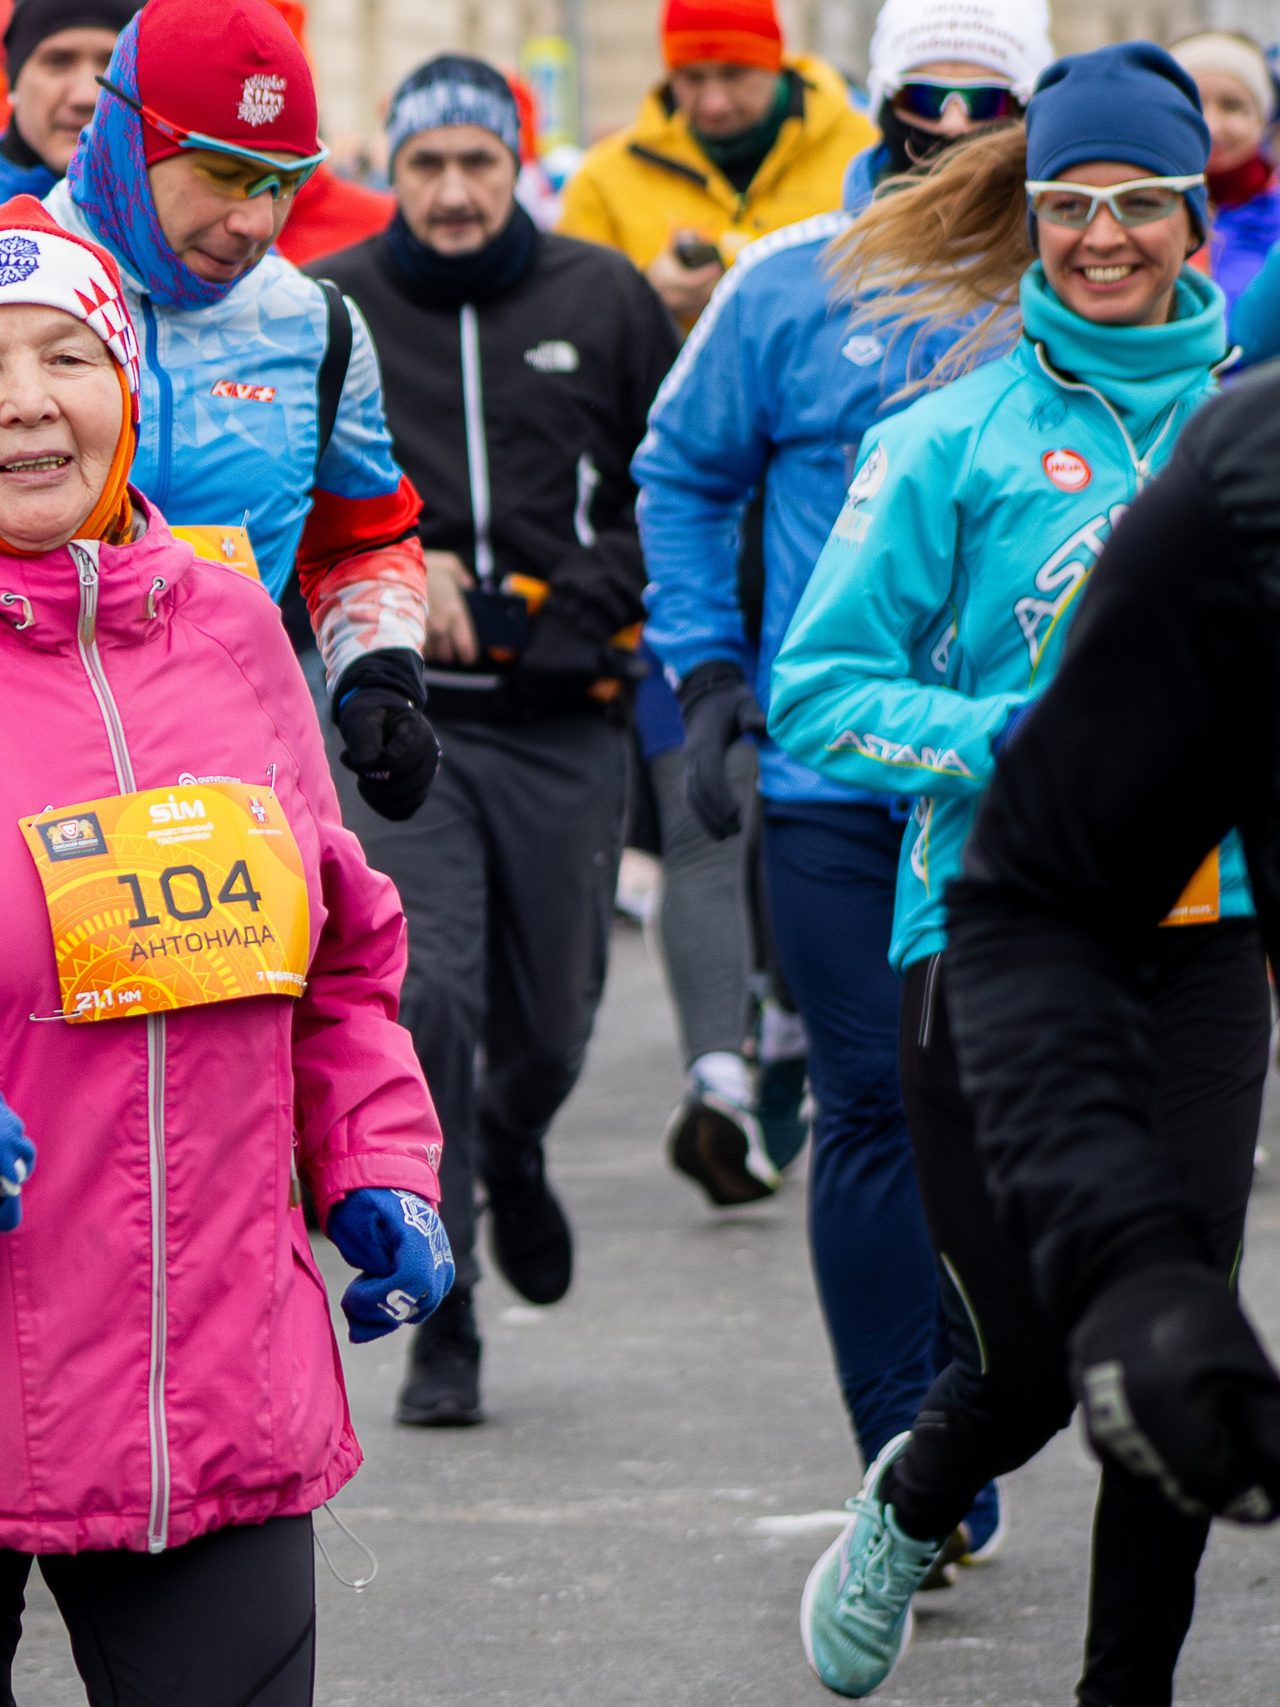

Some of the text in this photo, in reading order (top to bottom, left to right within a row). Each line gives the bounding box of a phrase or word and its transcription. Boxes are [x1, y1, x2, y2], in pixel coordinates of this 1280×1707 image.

[826, 730, 976, 779] ASTANA
[117, 859, 262, 929] 104
[130, 924, 276, 962] АНТОНИДА
